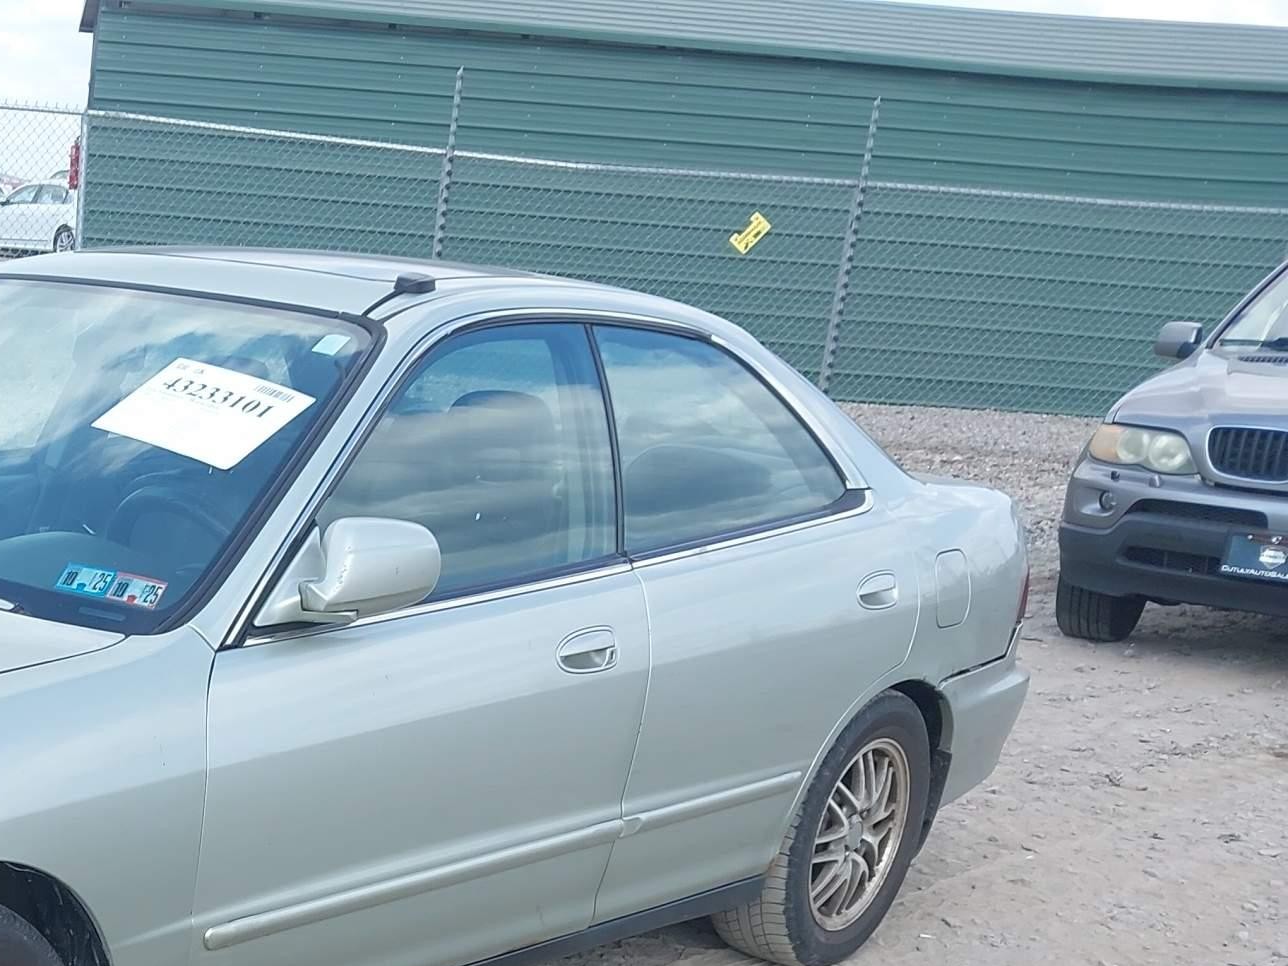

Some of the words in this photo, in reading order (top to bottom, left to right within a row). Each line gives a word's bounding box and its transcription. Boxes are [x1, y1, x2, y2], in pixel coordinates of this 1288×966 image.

[163, 377, 274, 418] 43233101
[63, 571, 78, 586] 10
[93, 572, 111, 591] 25
[113, 582, 129, 598] 10
[144, 585, 163, 604] 25
